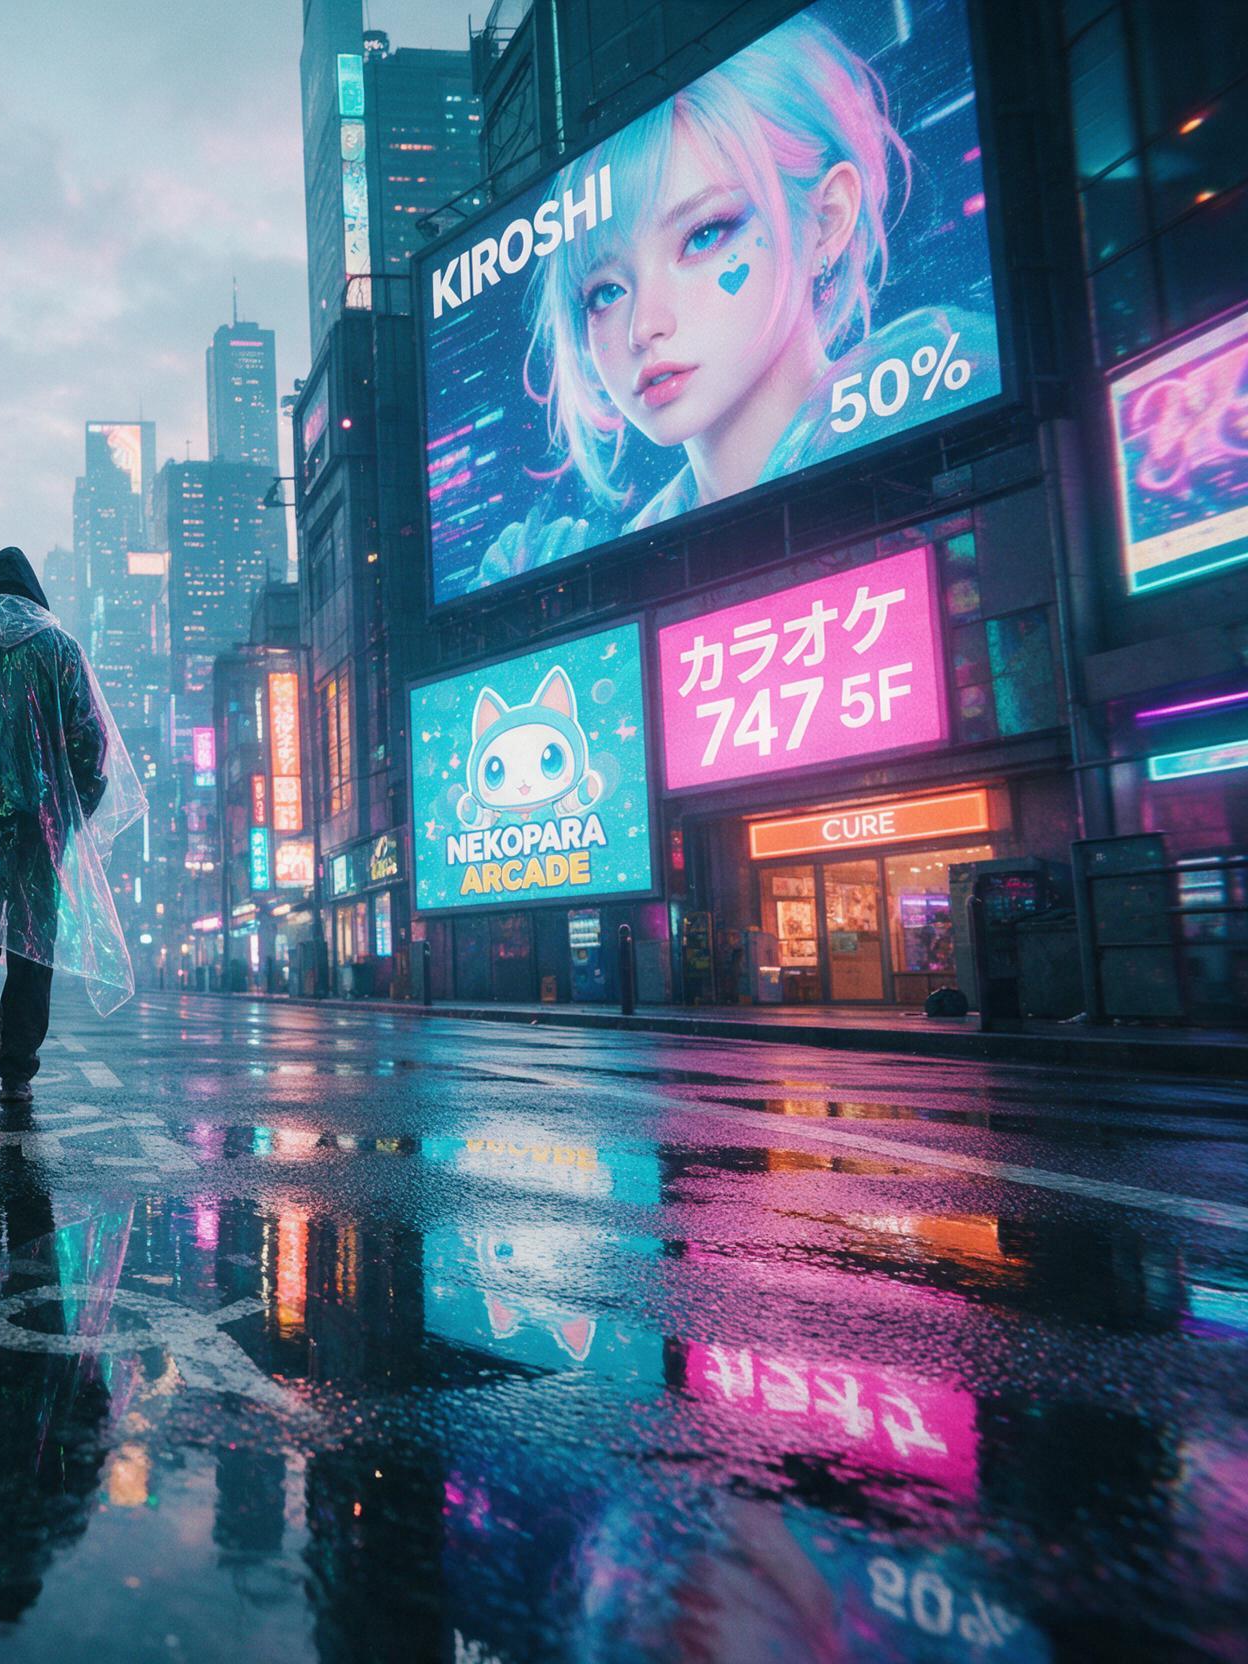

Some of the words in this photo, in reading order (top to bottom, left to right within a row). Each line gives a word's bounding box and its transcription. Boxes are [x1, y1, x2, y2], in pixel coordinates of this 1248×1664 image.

[432, 163, 613, 320] KIROSHI
[830, 331, 971, 434] 50%
[678, 586, 906, 698] カラオケ
[695, 676, 825, 768] 747
[839, 661, 914, 729] 5F
[446, 812, 608, 866] NEKOPARA
[459, 850, 592, 896] ARCADE
[821, 811, 897, 842] CURE
